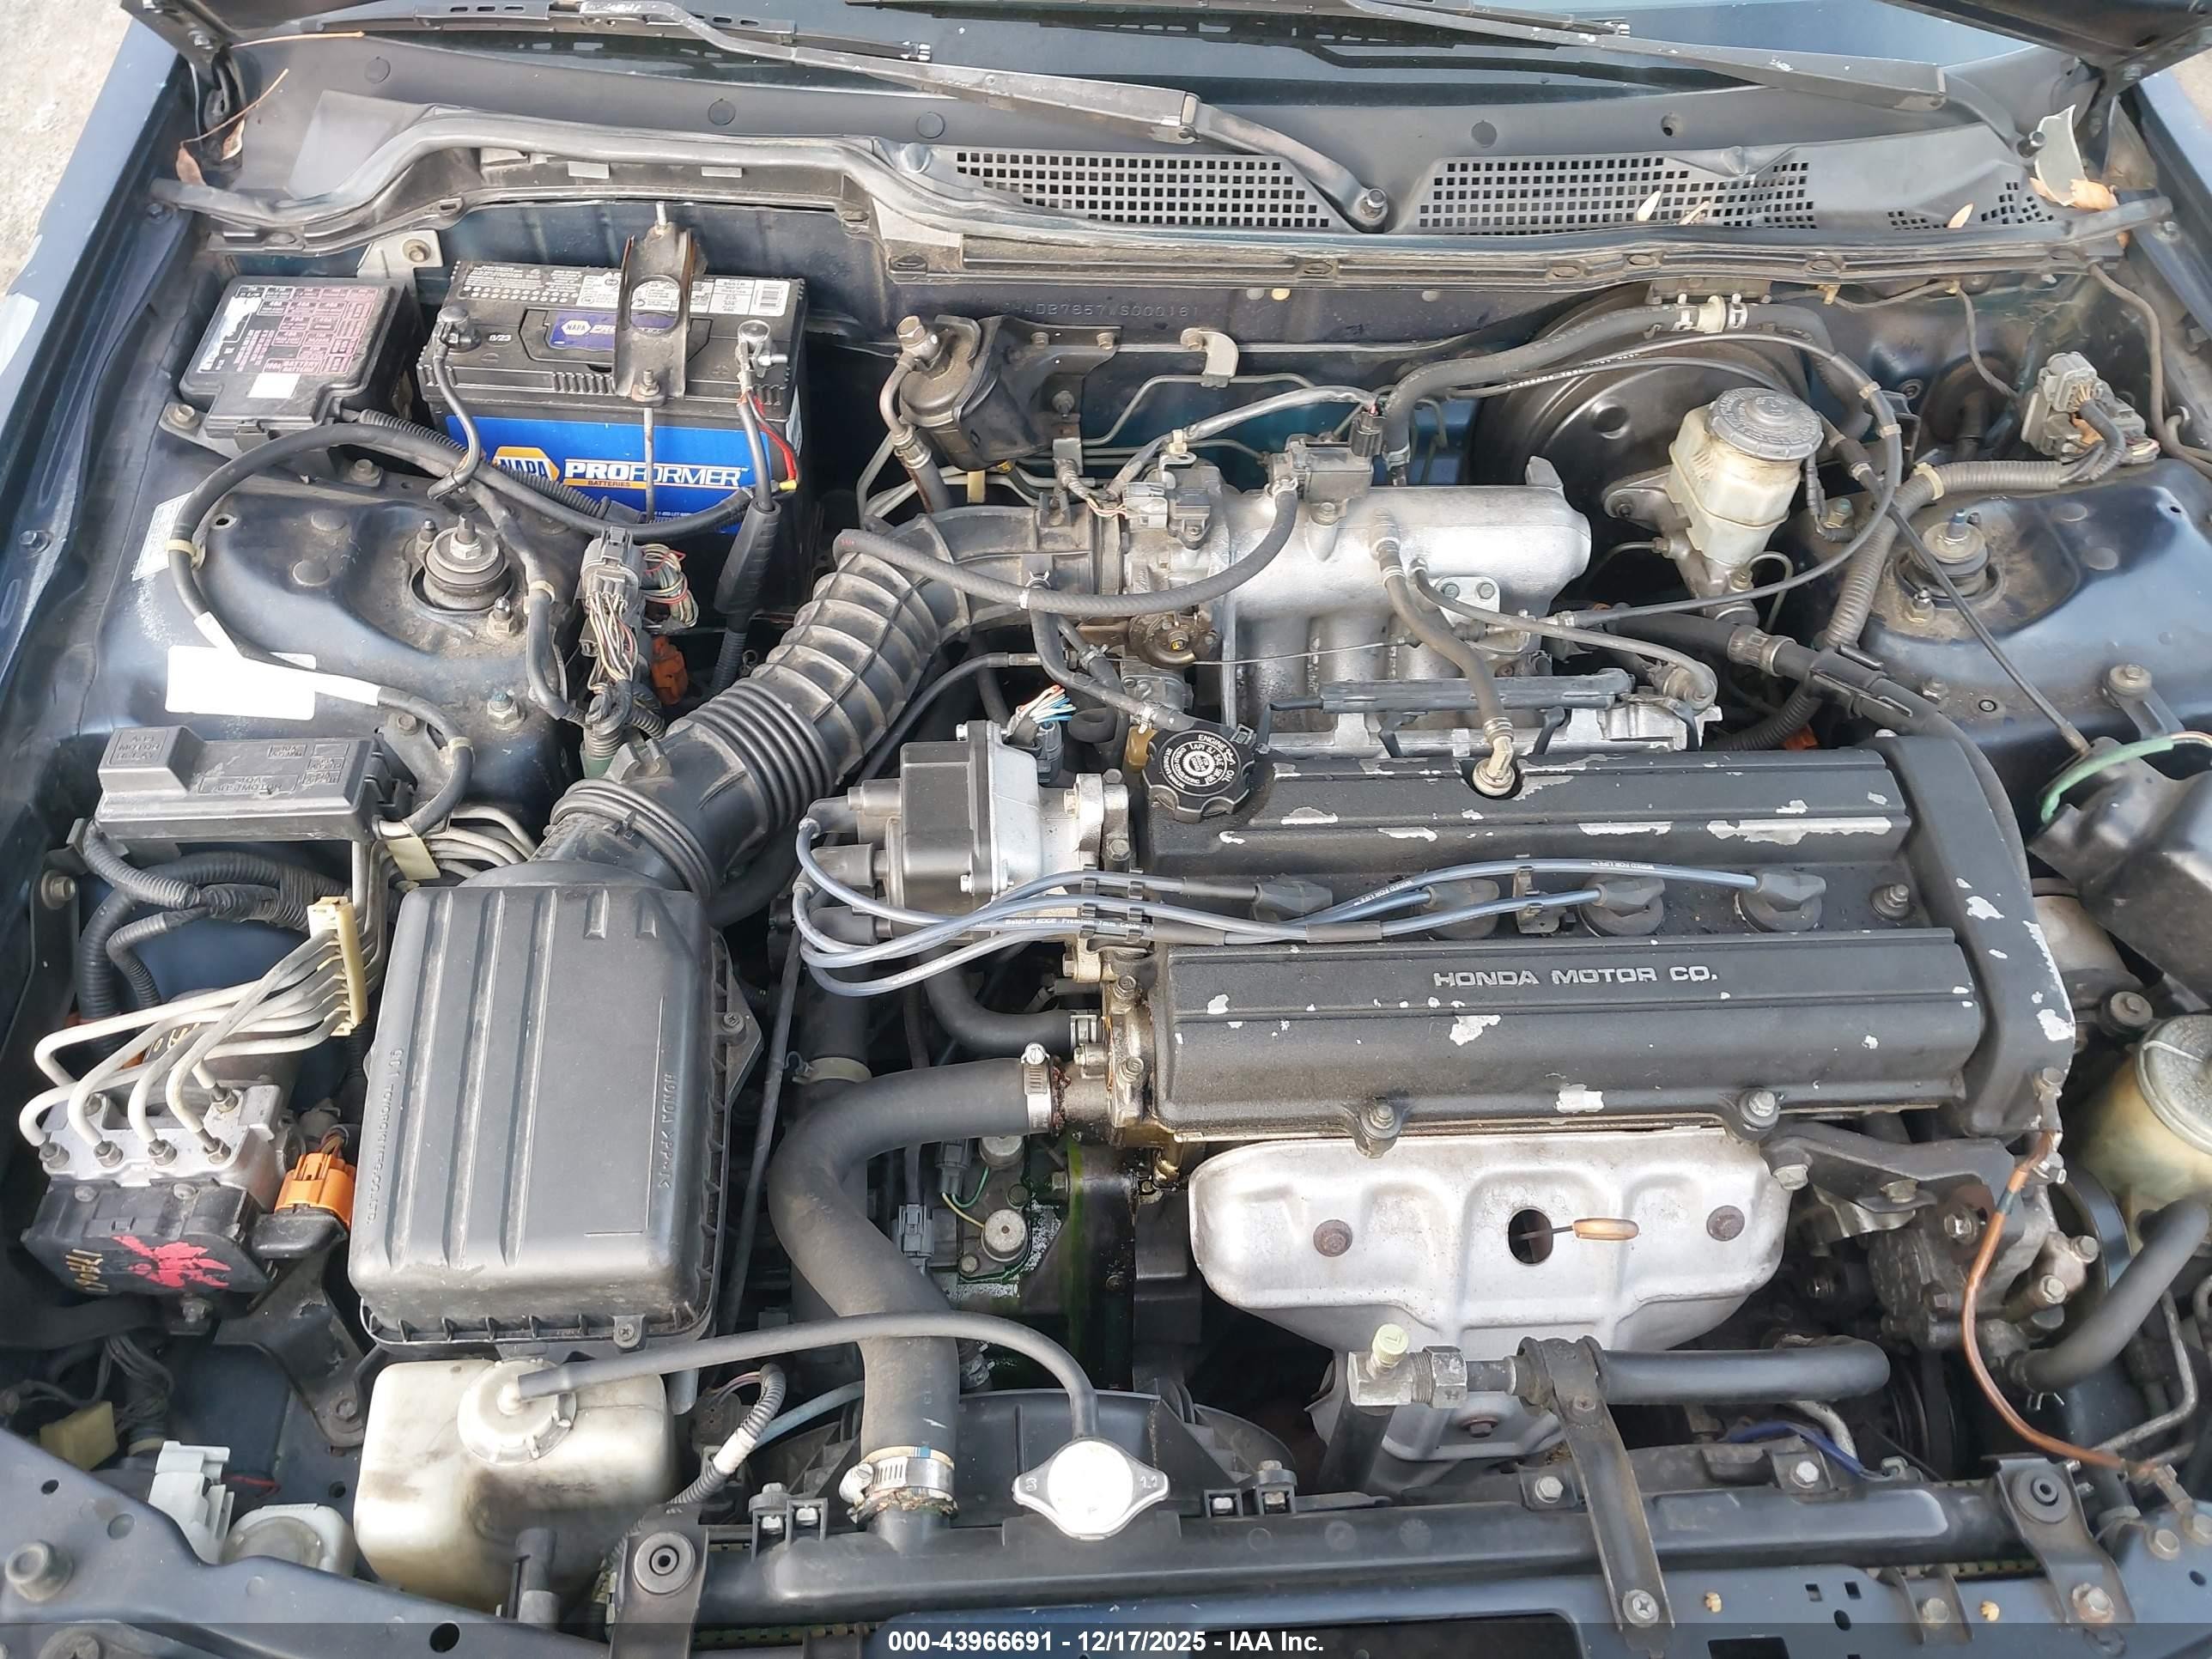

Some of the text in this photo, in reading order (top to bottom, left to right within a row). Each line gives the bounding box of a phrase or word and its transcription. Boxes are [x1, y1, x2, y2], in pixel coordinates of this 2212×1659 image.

[586, 479, 631, 489] BATTERIES
[1198, 734, 1227, 750] ENGINE
[1221, 769, 1236, 782] OIL
[1433, 965, 1718, 988] HONDA MOTOR CO.
[662, 1072, 678, 1124] HONDA
